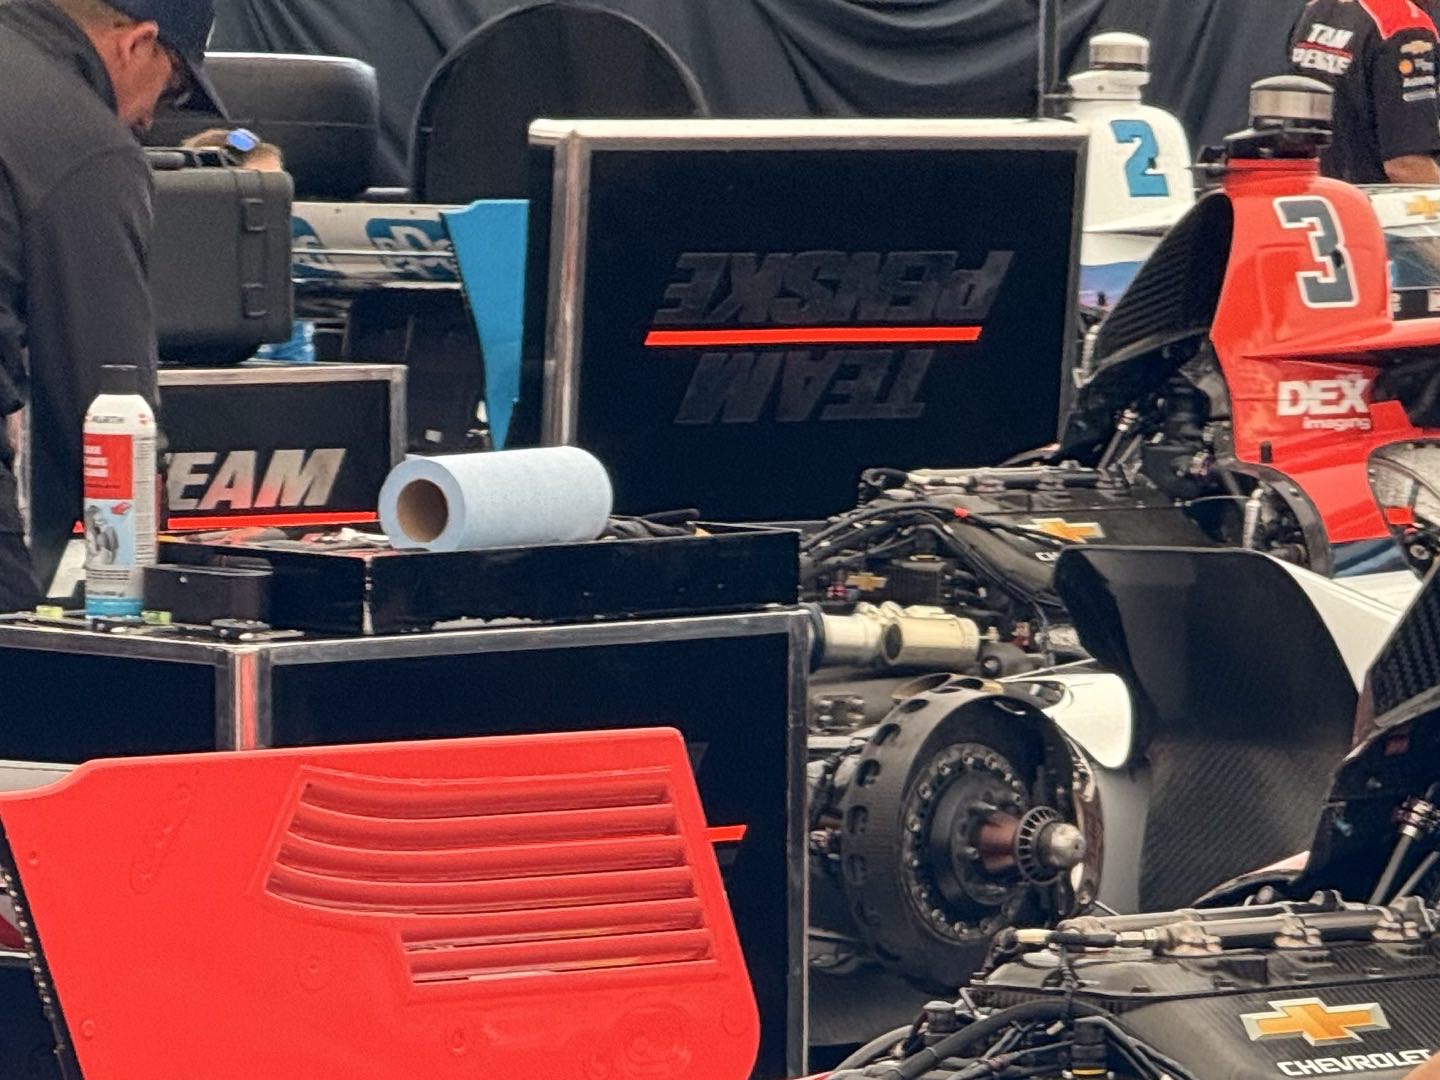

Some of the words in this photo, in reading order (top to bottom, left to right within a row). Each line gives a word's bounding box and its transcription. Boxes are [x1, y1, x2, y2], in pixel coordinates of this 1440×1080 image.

[1110, 119, 1170, 197] 2
[1272, 195, 1360, 309] 3
[1276, 379, 1371, 416] DEX
[163, 448, 346, 511] EAM
[1276, 1049, 1431, 1077] CHEVROLET
